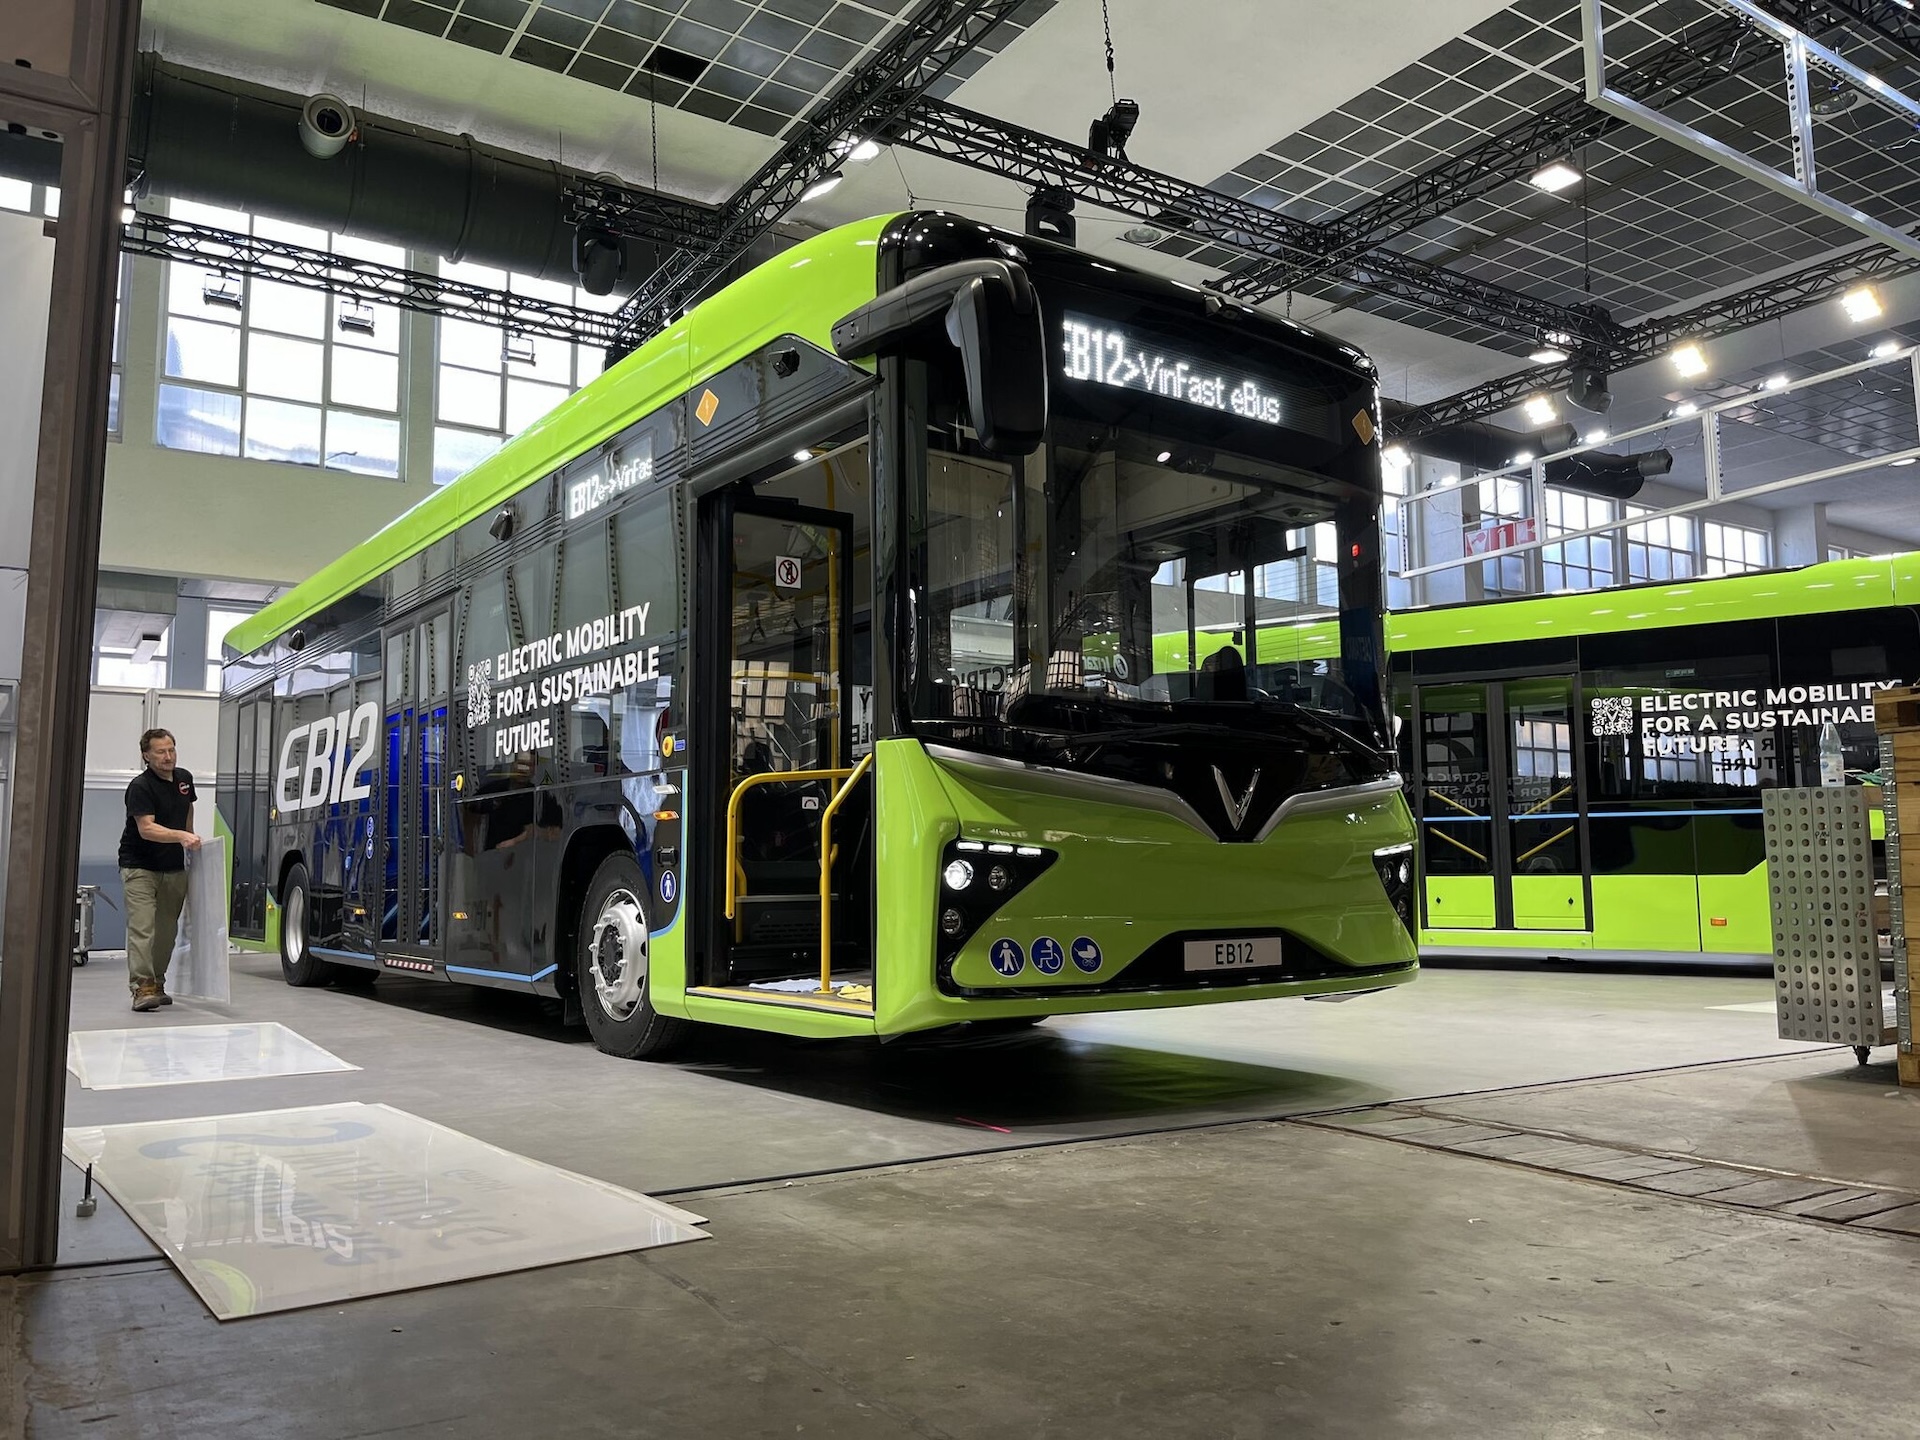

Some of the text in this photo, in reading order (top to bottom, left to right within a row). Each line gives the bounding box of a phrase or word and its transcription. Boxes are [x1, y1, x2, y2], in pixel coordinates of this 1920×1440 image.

[1230, 381, 1281, 424] eBus
[497, 602, 650, 681] ELECTRIC MOBILITY
[496, 646, 660, 719] FOR A SUSTAINABLE
[1641, 690, 1757, 713] ELECTRIC
[495, 718, 554, 758] FUTURE.
[1641, 715, 1690, 734] FOR
[1698, 713, 1718, 732] A
[276, 701, 379, 813] EB12
[1215, 942, 1254, 965] EB12
